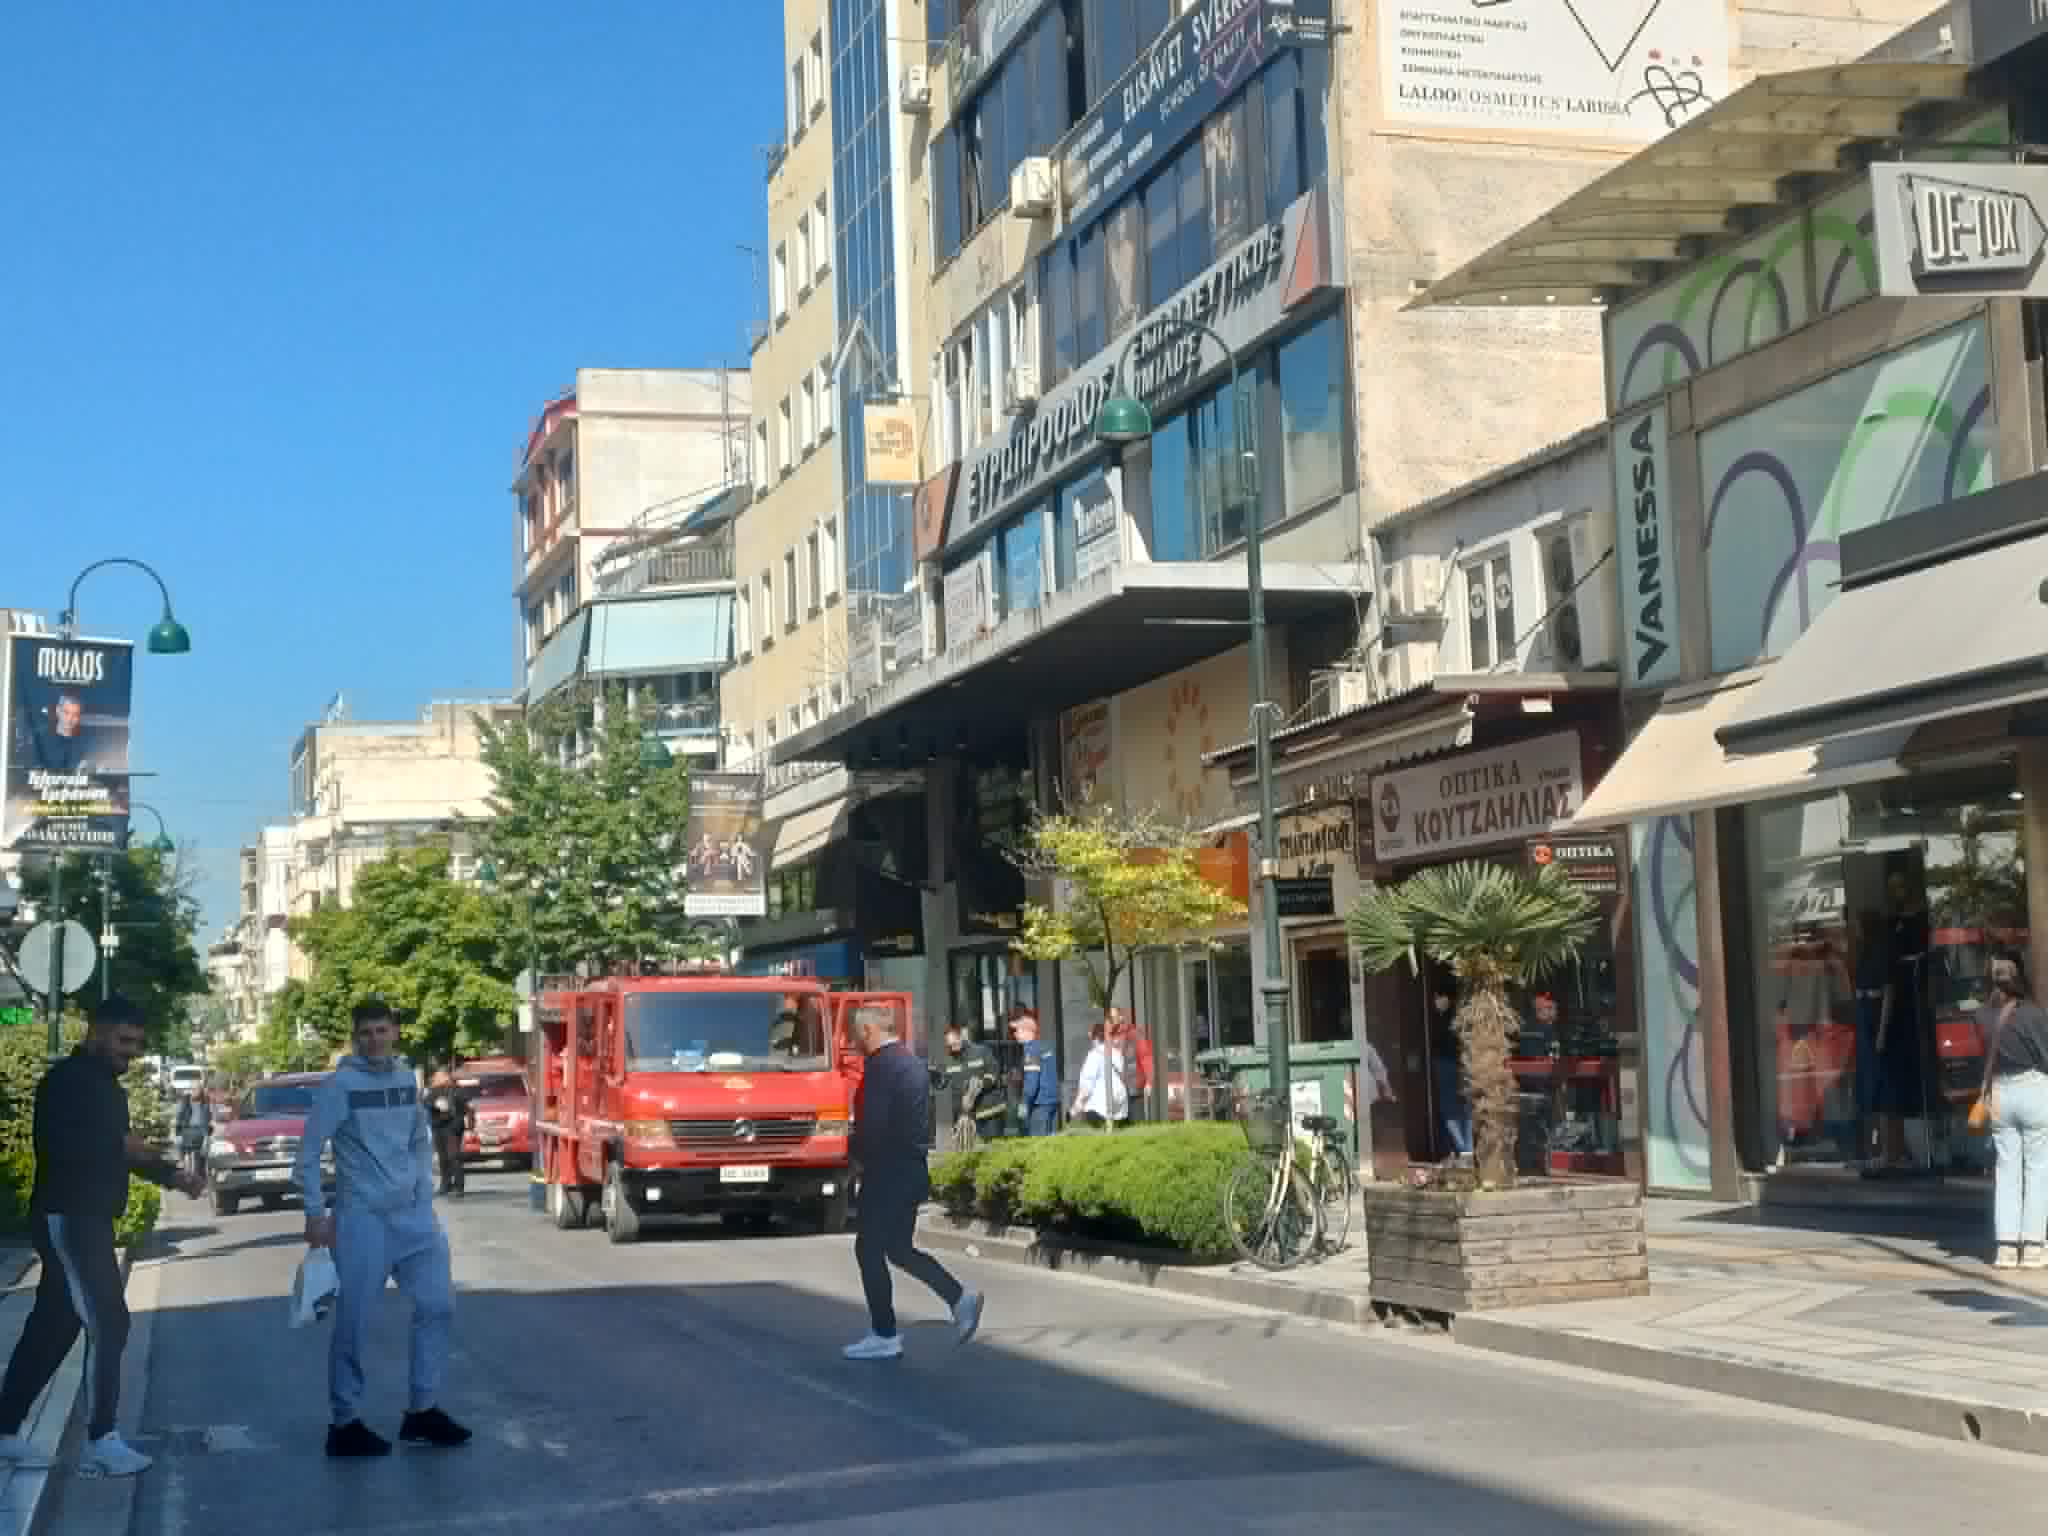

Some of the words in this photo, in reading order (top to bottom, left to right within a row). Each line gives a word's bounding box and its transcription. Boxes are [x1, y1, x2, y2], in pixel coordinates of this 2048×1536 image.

[1927, 190, 2020, 266] DE-TOX
[1630, 415, 1669, 680] VANESSA
[1439, 760, 1521, 798] ΟΠΤΙΚΑ
